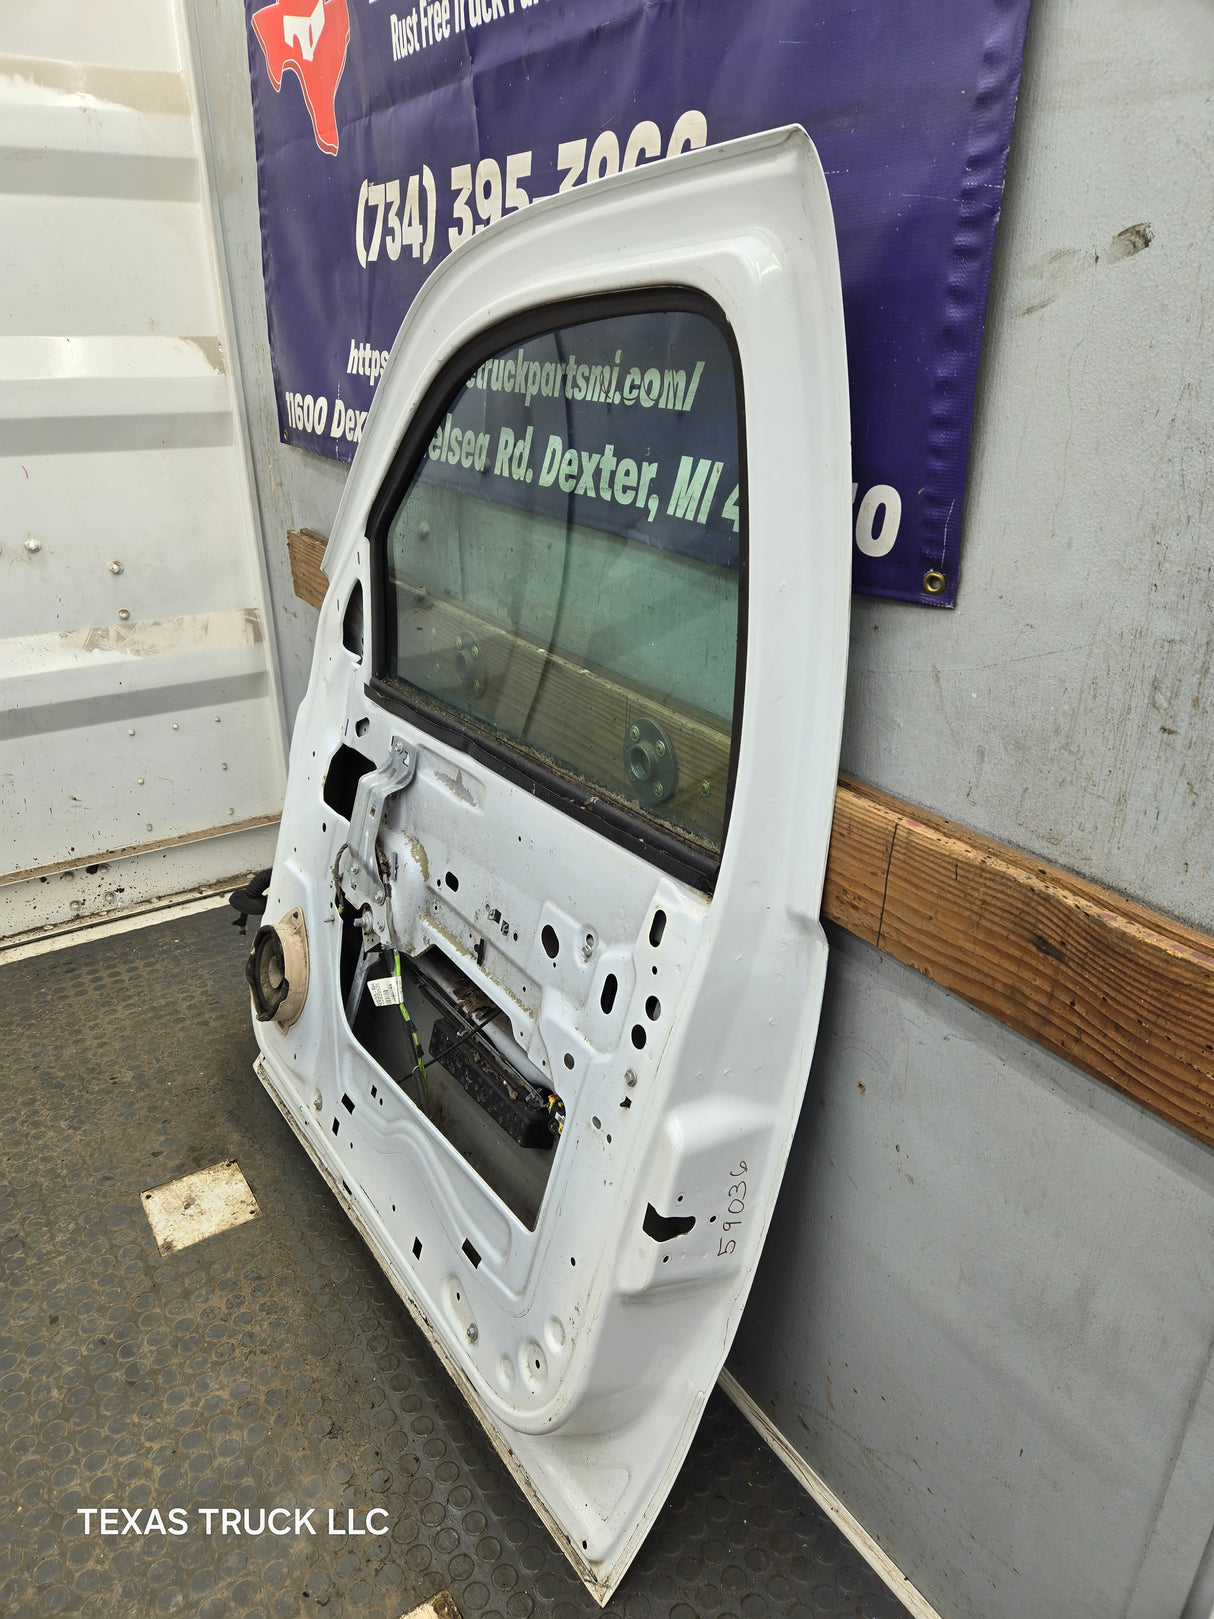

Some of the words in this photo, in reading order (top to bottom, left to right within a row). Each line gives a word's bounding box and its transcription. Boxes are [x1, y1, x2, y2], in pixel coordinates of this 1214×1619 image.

[390, 8, 420, 61] Rust
[419, 0, 450, 49] Free
[355, 164, 436, 269] (734)
[286, 391, 328, 435] 11600
[424, 413, 490, 471] elsea
[494, 426, 534, 483] Rd.
[538, 435, 659, 522] Dexter,
[666, 455, 724, 525] MI
[717, 1160, 748, 1256] 59036
